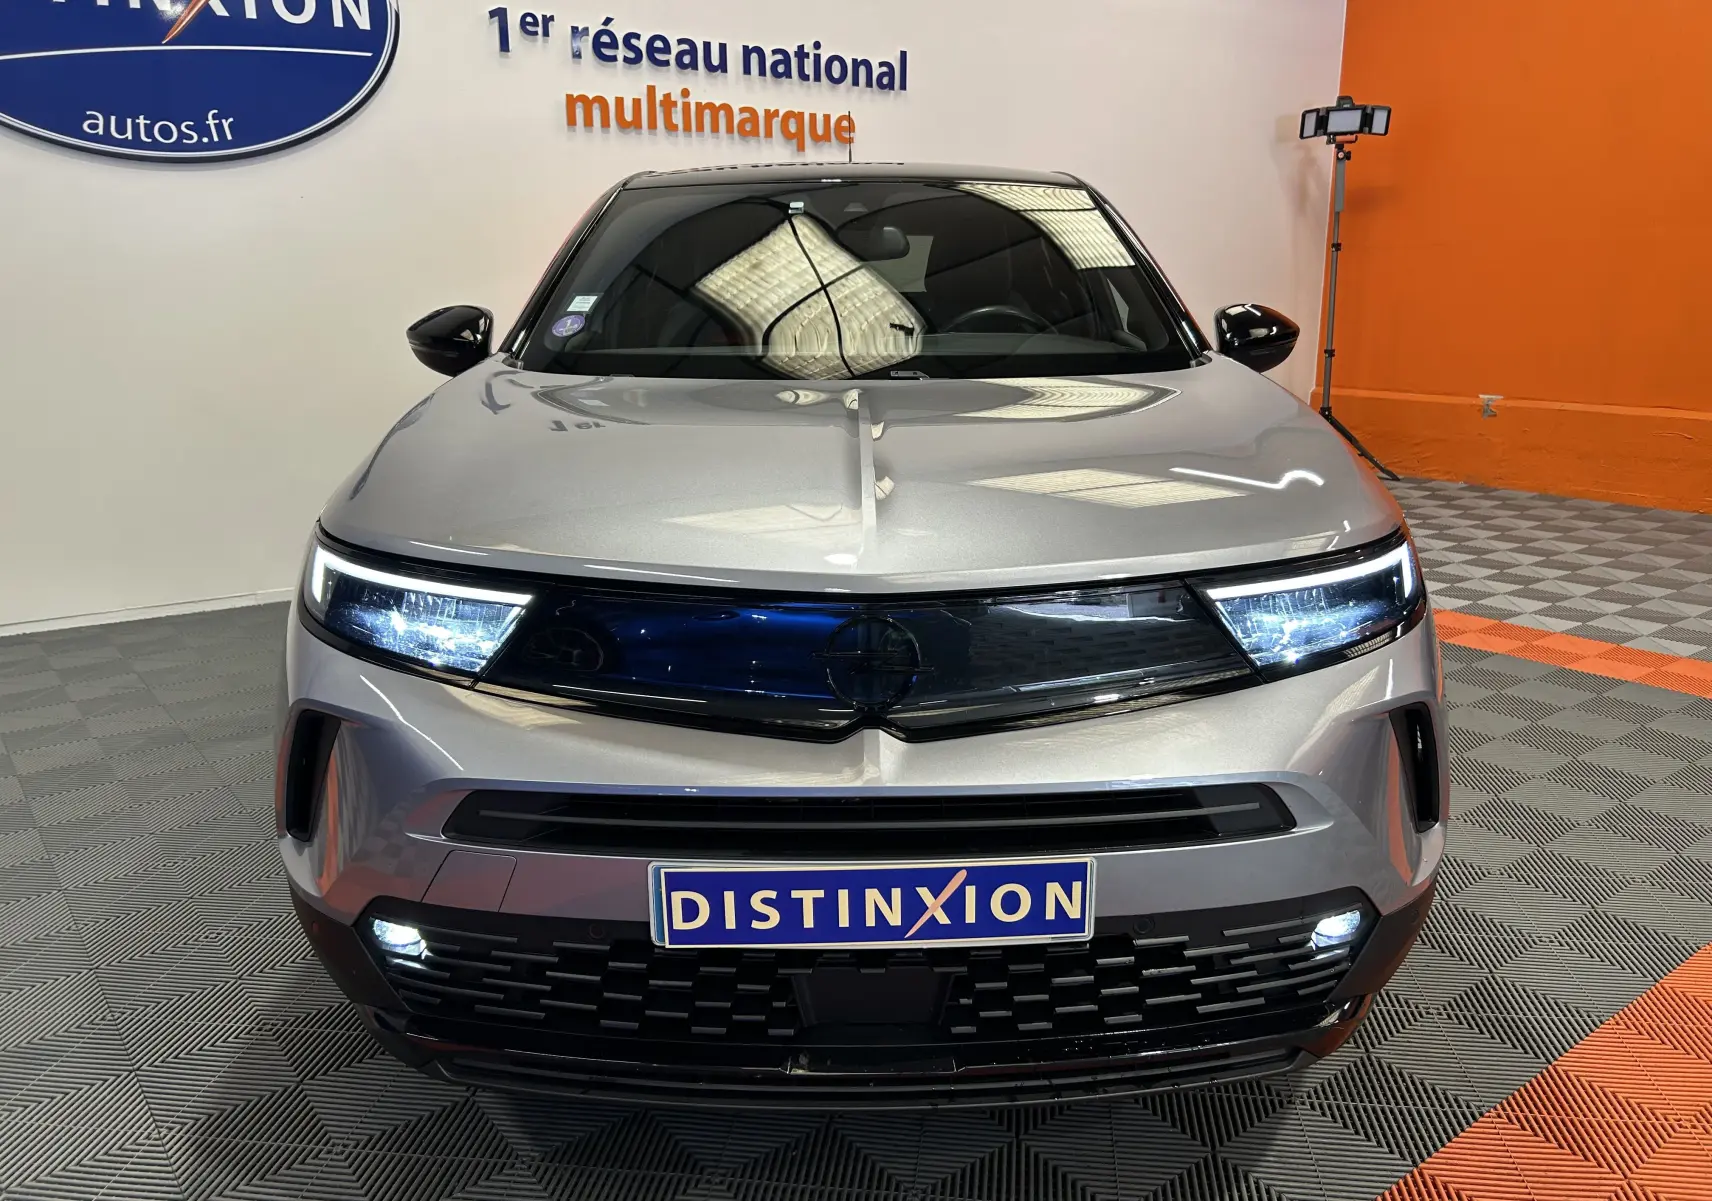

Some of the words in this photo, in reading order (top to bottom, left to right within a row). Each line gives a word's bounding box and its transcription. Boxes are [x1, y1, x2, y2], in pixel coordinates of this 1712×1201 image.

[570, 17, 728, 74] réseau
[742, 41, 908, 91] national
[82, 109, 235, 143] autos.fr
[565, 85, 856, 152] multimarque
[670, 868, 1082, 939] DISTINXION
